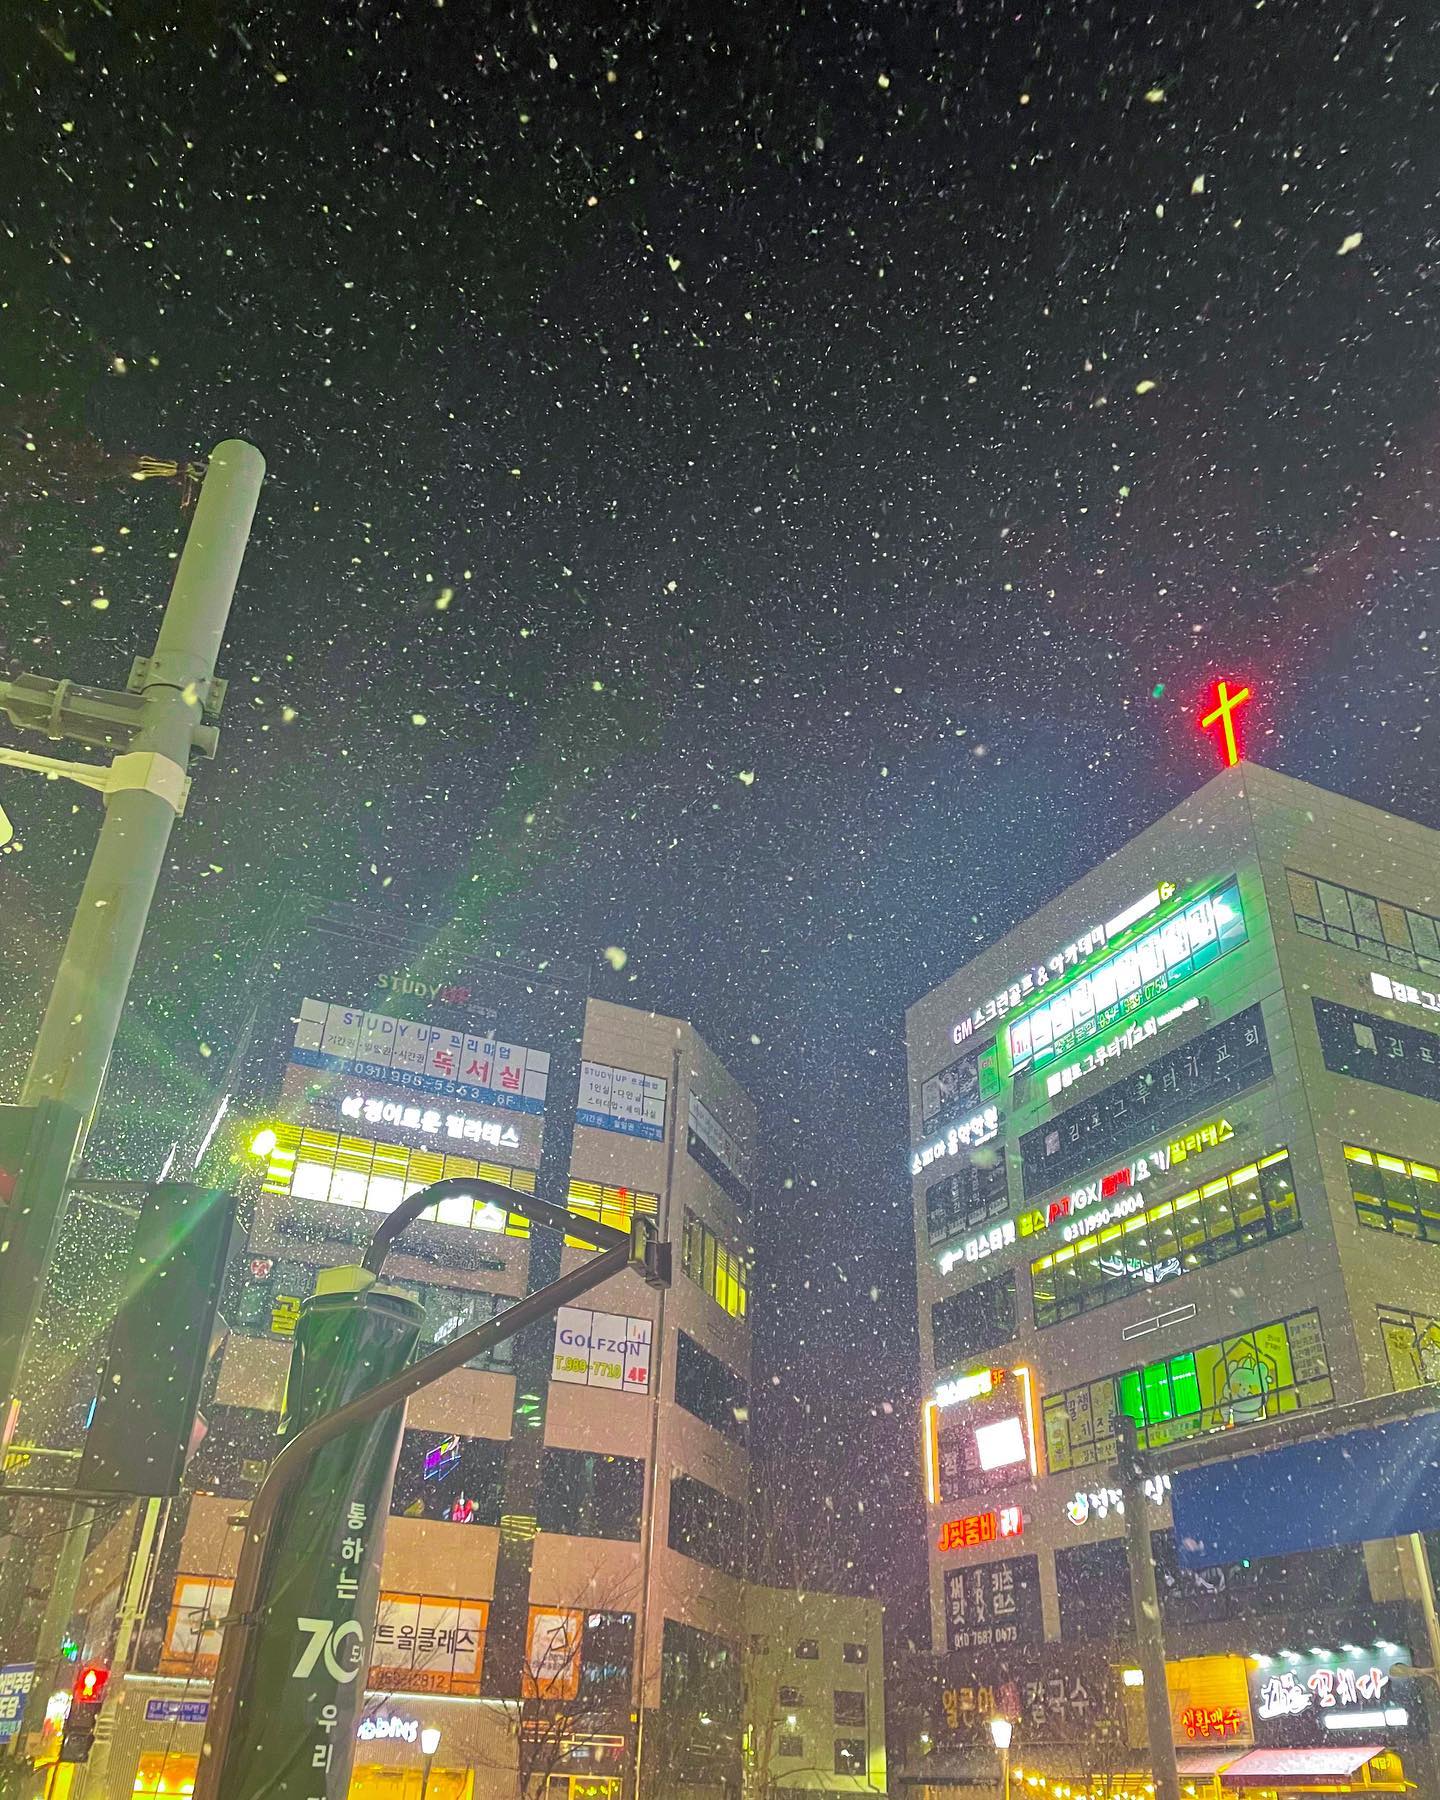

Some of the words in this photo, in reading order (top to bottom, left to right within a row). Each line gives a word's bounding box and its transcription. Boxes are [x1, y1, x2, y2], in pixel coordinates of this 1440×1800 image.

[343, 1012, 409, 1037] STUDY
[417, 1025, 441, 1043] UP
[432, 1050, 521, 1090] 독서실
[585, 1067, 612, 1080] STUDY
[616, 1074, 627, 1083] UP
[560, 1329, 640, 1356] GOLFZON
[628, 1367, 647, 1382] 4F
